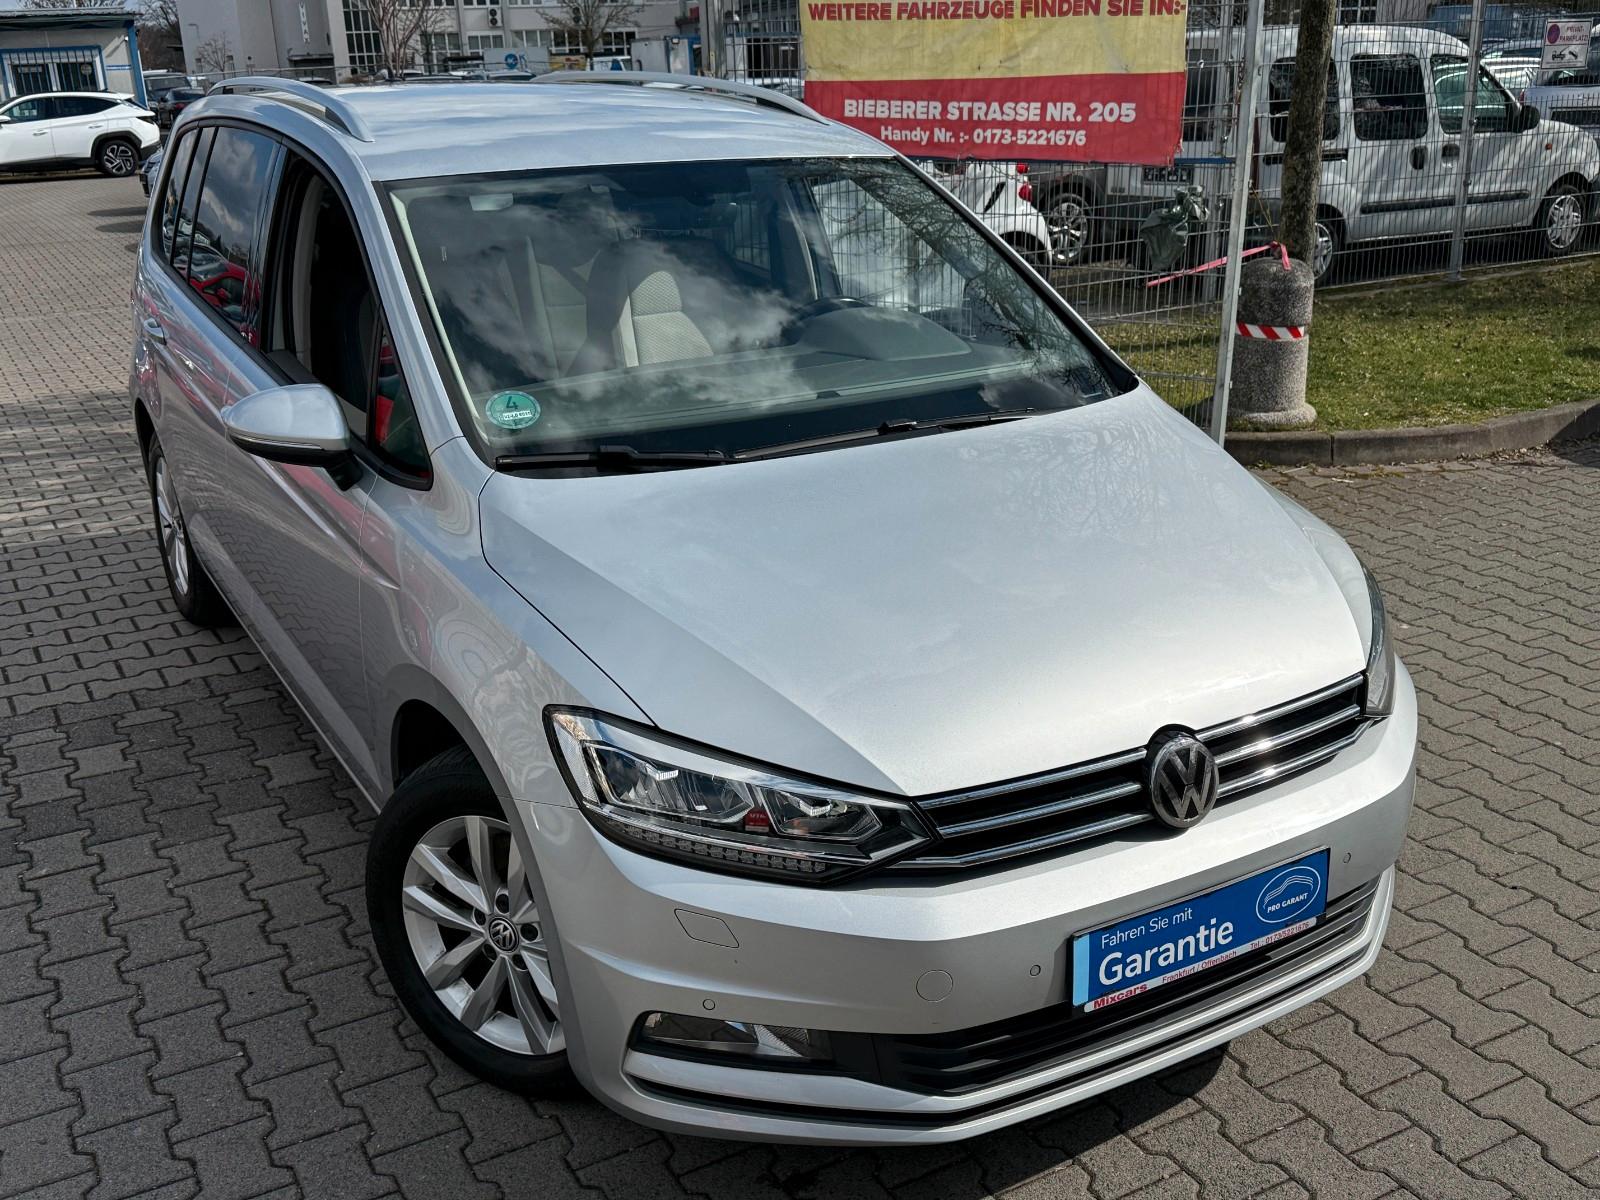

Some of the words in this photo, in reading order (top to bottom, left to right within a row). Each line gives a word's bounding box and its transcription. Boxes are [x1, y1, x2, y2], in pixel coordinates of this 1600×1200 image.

[808, 1, 892, 21] WEITERE
[896, 0, 1015, 20] FAHRZEUGE
[1020, 0, 1100, 18] FINDEN
[1107, 0, 1142, 16] SIE
[844, 98, 941, 120] BIEBERER
[949, 100, 1042, 122] STRASSE
[1045, 101, 1082, 122] NR.
[1088, 102, 1137, 123] 205
[880, 125, 930, 144] Handy
[933, 127, 956, 143] Nr.
[972, 127, 1086, 146] 0173-5221676
[506, 396, 518, 409] 4
[1267, 904, 1281, 914] PRO
[1281, 892, 1309, 908] GARANT
[1101, 925, 1145, 950] Fahren
[1149, 916, 1169, 933] Sie
[1172, 907, 1193, 925] mit
[1098, 917, 1234, 986] Garantie
[1093, 982, 1148, 1010] Mixcars
[1162, 965, 1196, 984] Frankfurt
[1201, 950, 1237, 970] Offenbach
